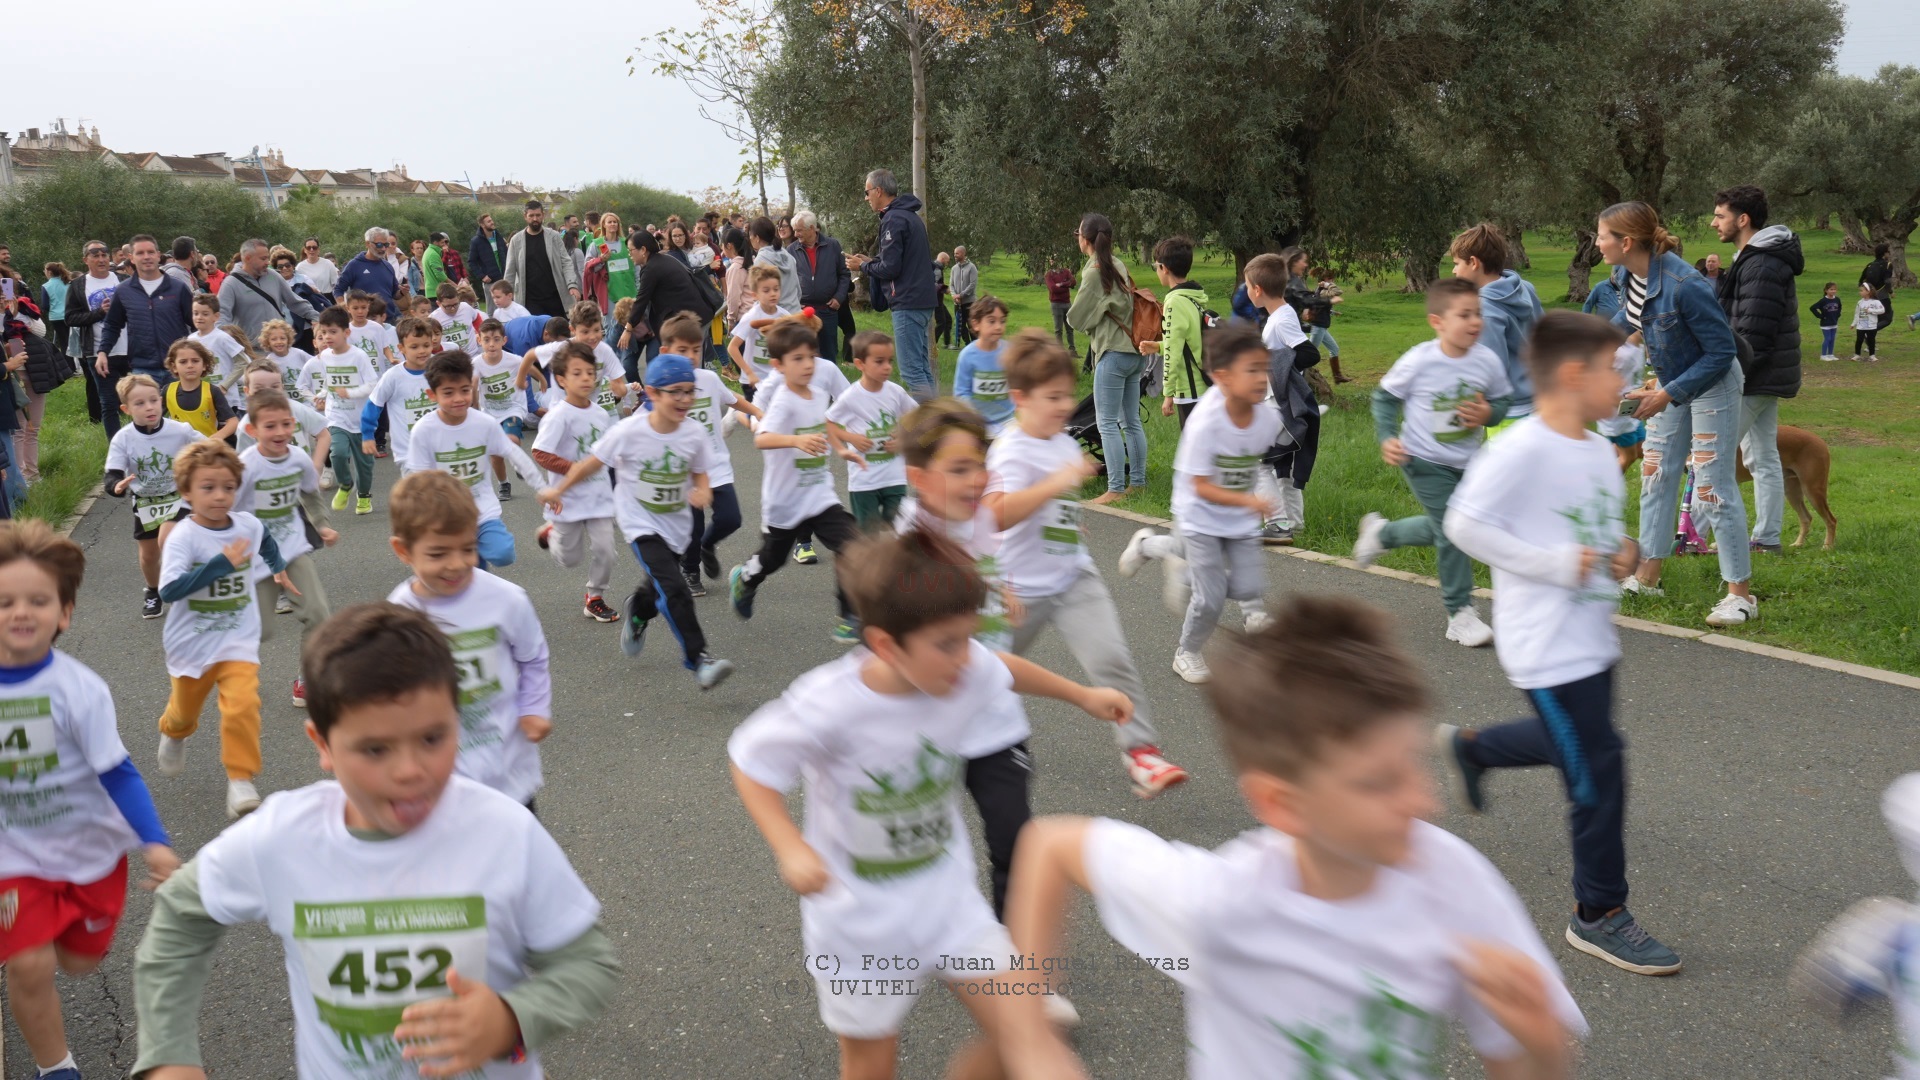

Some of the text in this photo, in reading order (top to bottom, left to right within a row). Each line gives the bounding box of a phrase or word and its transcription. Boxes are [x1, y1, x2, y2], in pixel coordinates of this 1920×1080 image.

[445, 333, 462, 342] 261
[1163, 346, 1171, 382] YOUTH
[331, 375, 350, 385] 313
[487, 382, 508, 393] 453
[450, 461, 478, 477] 312
[269, 488, 296, 507] 317
[651, 486, 681, 502] 311
[149, 503, 174, 518] 017
[208, 575, 244, 598] 155
[328, 944, 454, 997] 452
